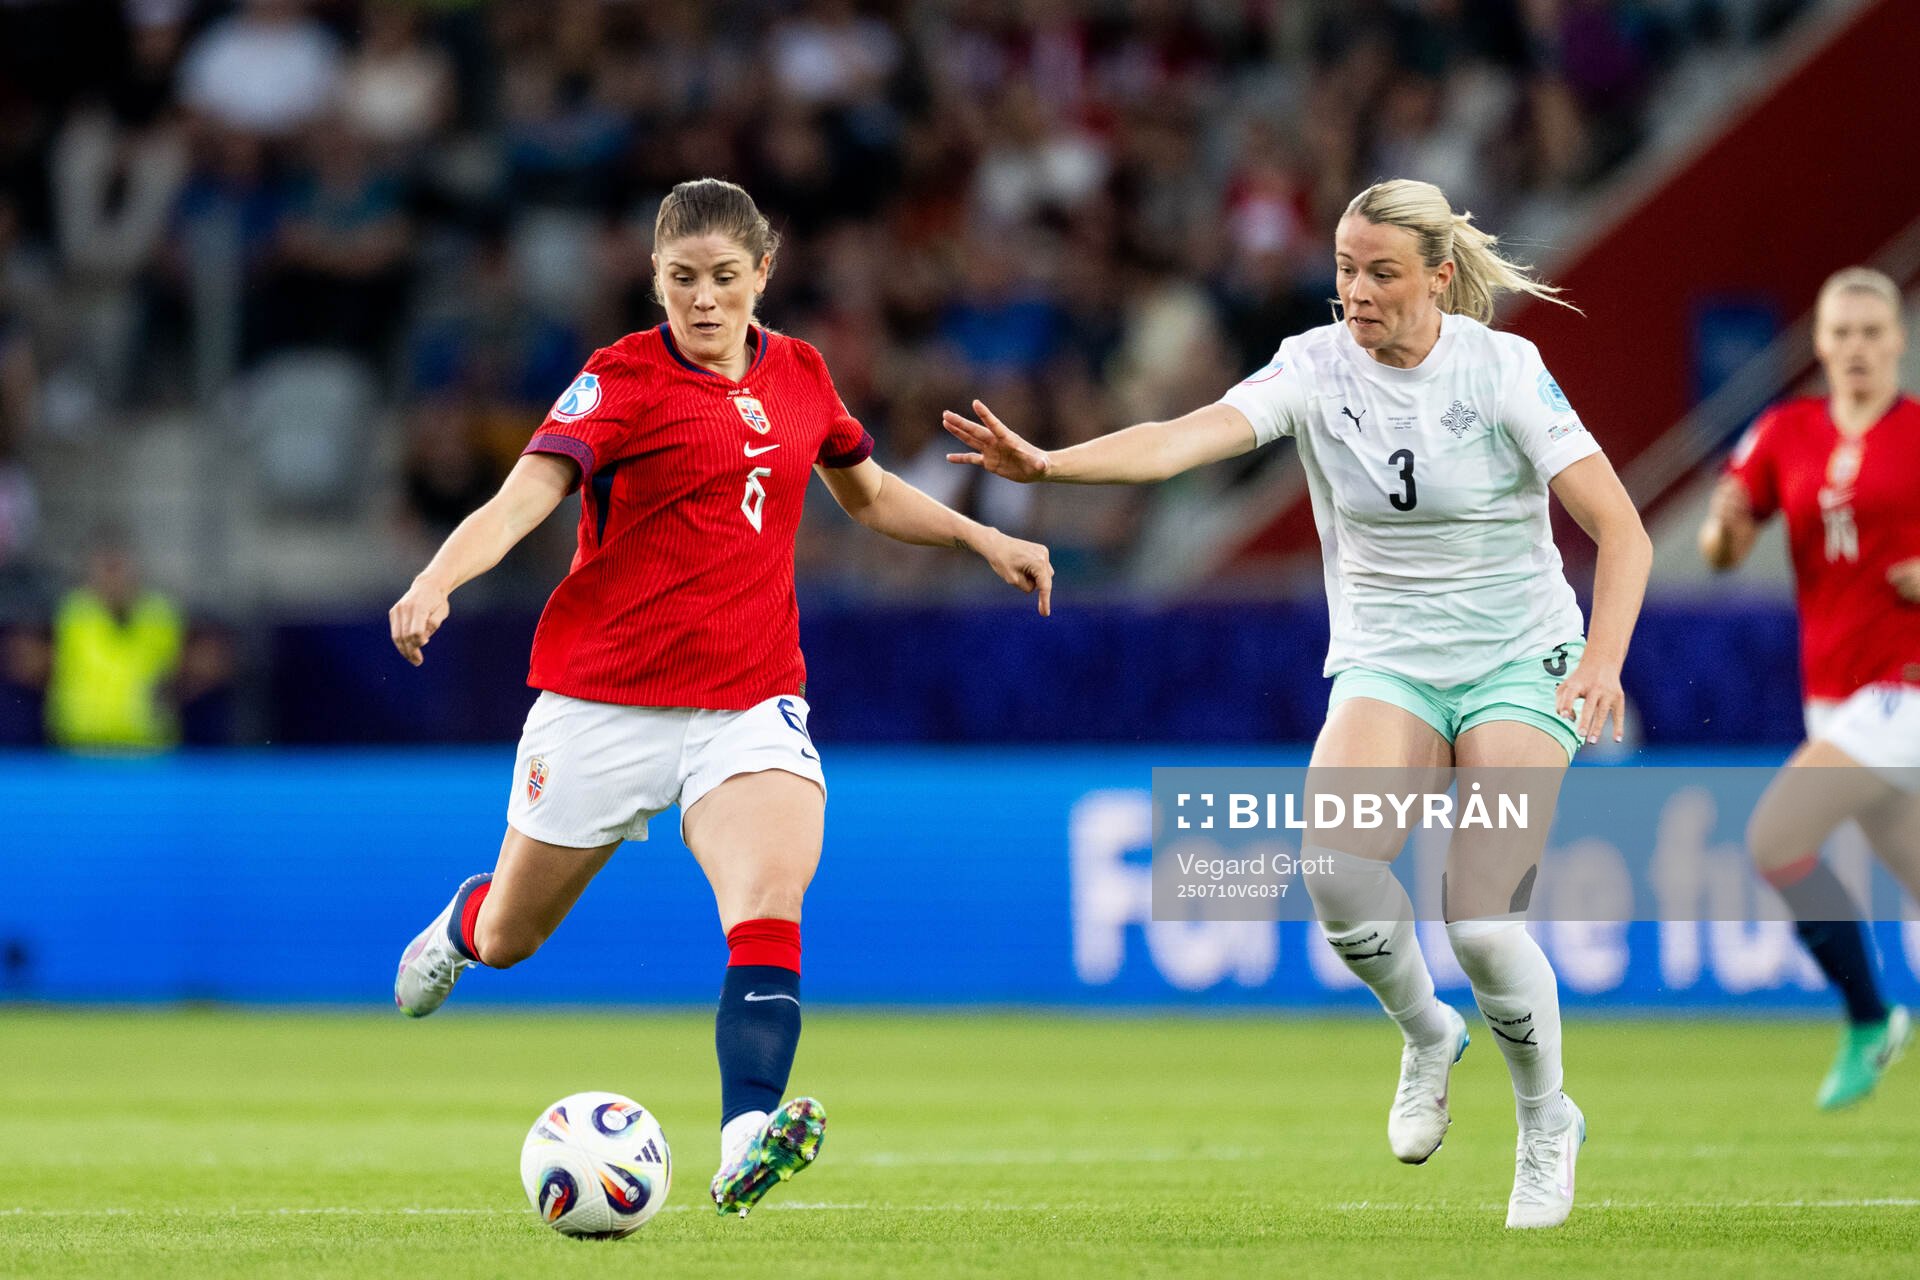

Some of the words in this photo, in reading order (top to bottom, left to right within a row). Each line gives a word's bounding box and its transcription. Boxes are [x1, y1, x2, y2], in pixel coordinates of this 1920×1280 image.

[741, 466, 772, 535] 6
[1388, 449, 1417, 511] 3
[1543, 642, 1568, 677] 3
[777, 697, 810, 742] 6
